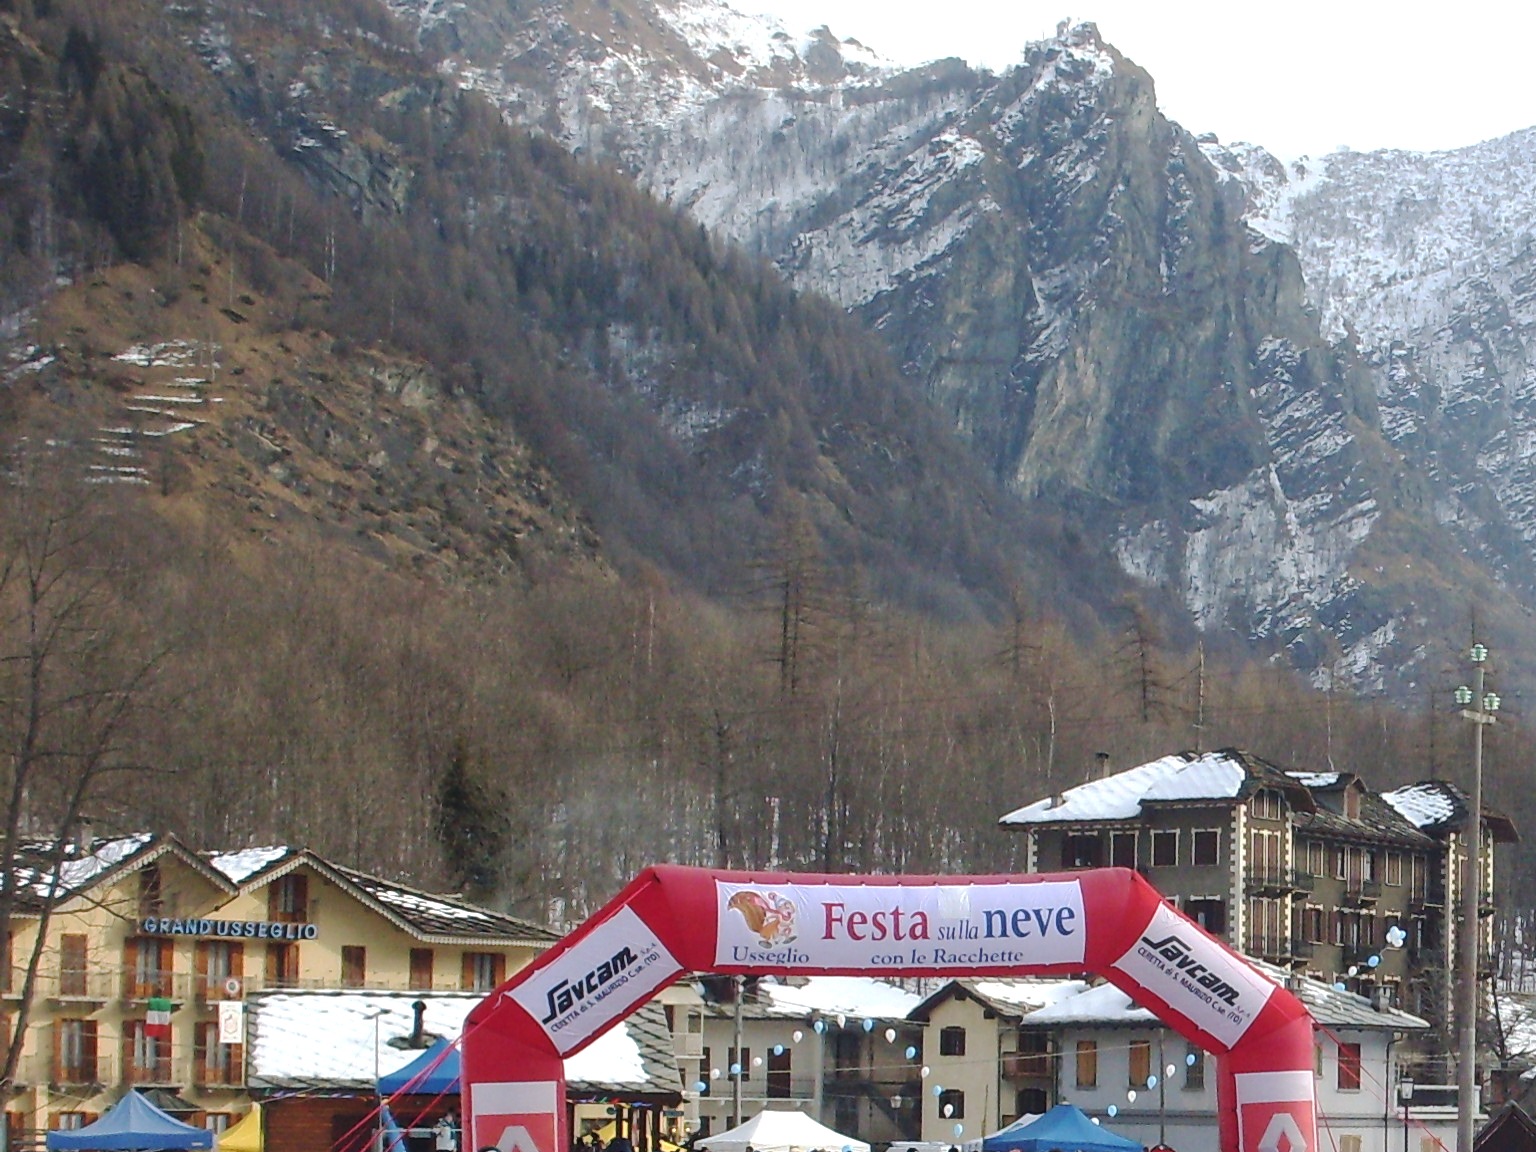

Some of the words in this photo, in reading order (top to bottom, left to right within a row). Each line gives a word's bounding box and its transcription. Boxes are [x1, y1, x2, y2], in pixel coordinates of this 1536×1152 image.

[821, 902, 930, 941] Festa
[937, 919, 979, 940] sulla
[982, 905, 1075, 938] neve
[733, 946, 809, 965] Usseglio
[871, 954, 904, 965] con
[911, 949, 927, 963] le
[933, 948, 1023, 963] Racchette
[1141, 935, 1240, 1007] Savcam
[542, 946, 638, 1025] Savcam
